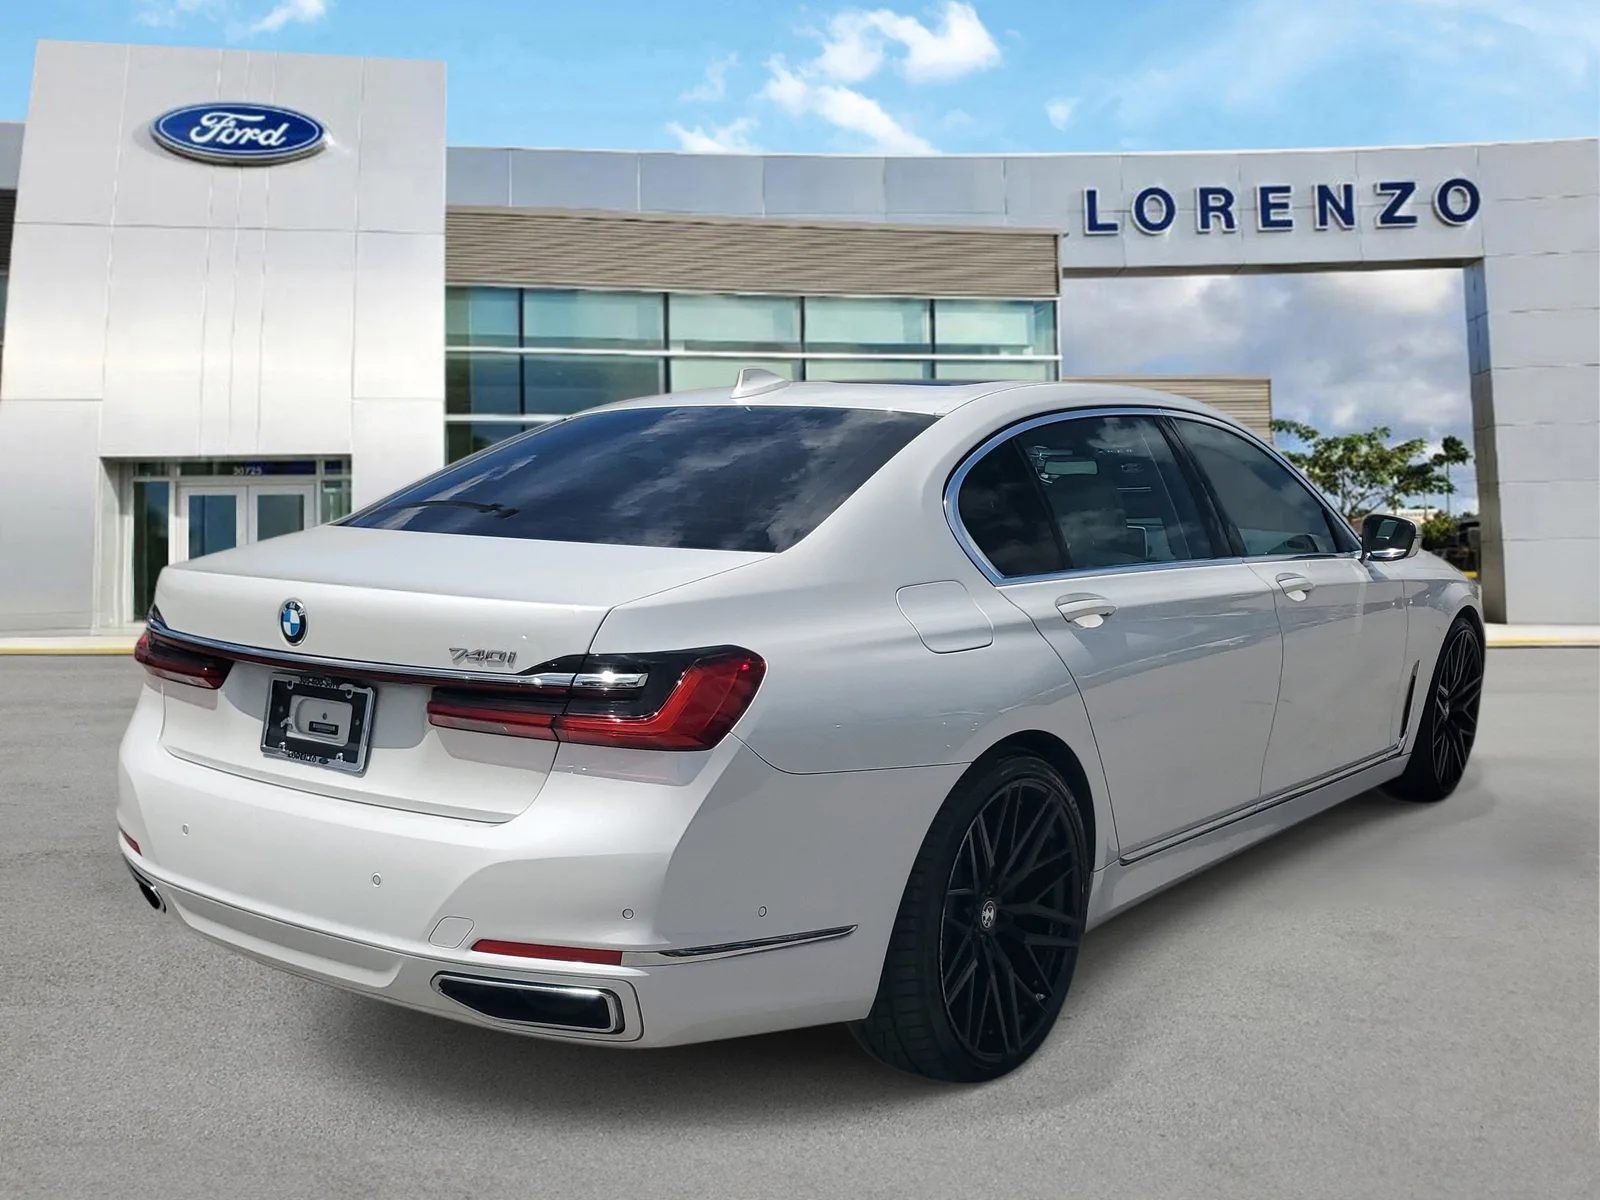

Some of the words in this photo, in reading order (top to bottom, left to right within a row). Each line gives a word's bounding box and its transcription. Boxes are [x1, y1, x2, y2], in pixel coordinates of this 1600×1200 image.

[189, 111, 290, 146] Ford
[1083, 177, 1481, 236] LORENZO
[449, 647, 517, 664] 740i
